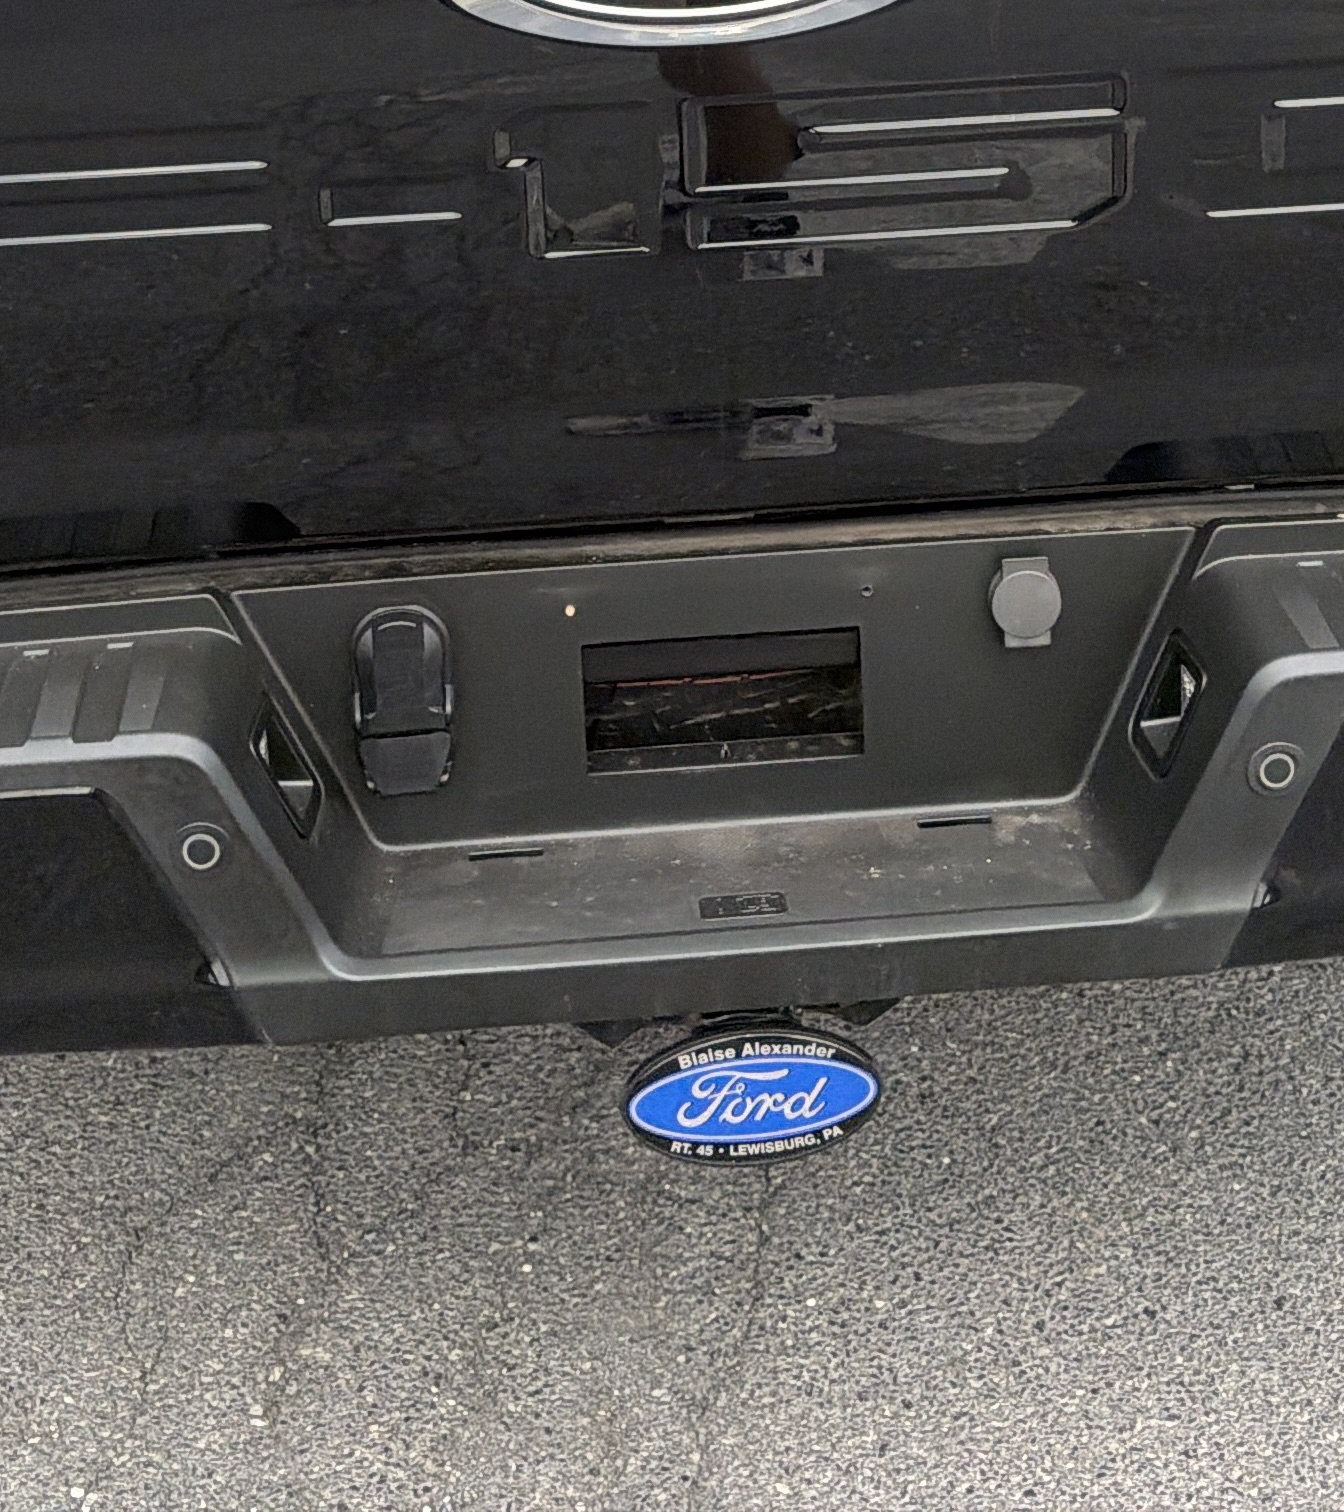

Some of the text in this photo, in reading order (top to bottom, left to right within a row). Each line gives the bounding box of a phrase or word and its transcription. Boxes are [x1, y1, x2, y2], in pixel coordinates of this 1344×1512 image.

[677, 1041, 837, 1070] Blaise Alexander
[676, 1067, 829, 1128] Ford
[670, 1125, 845, 1157] RT. 45 LEWISBURG, PA
